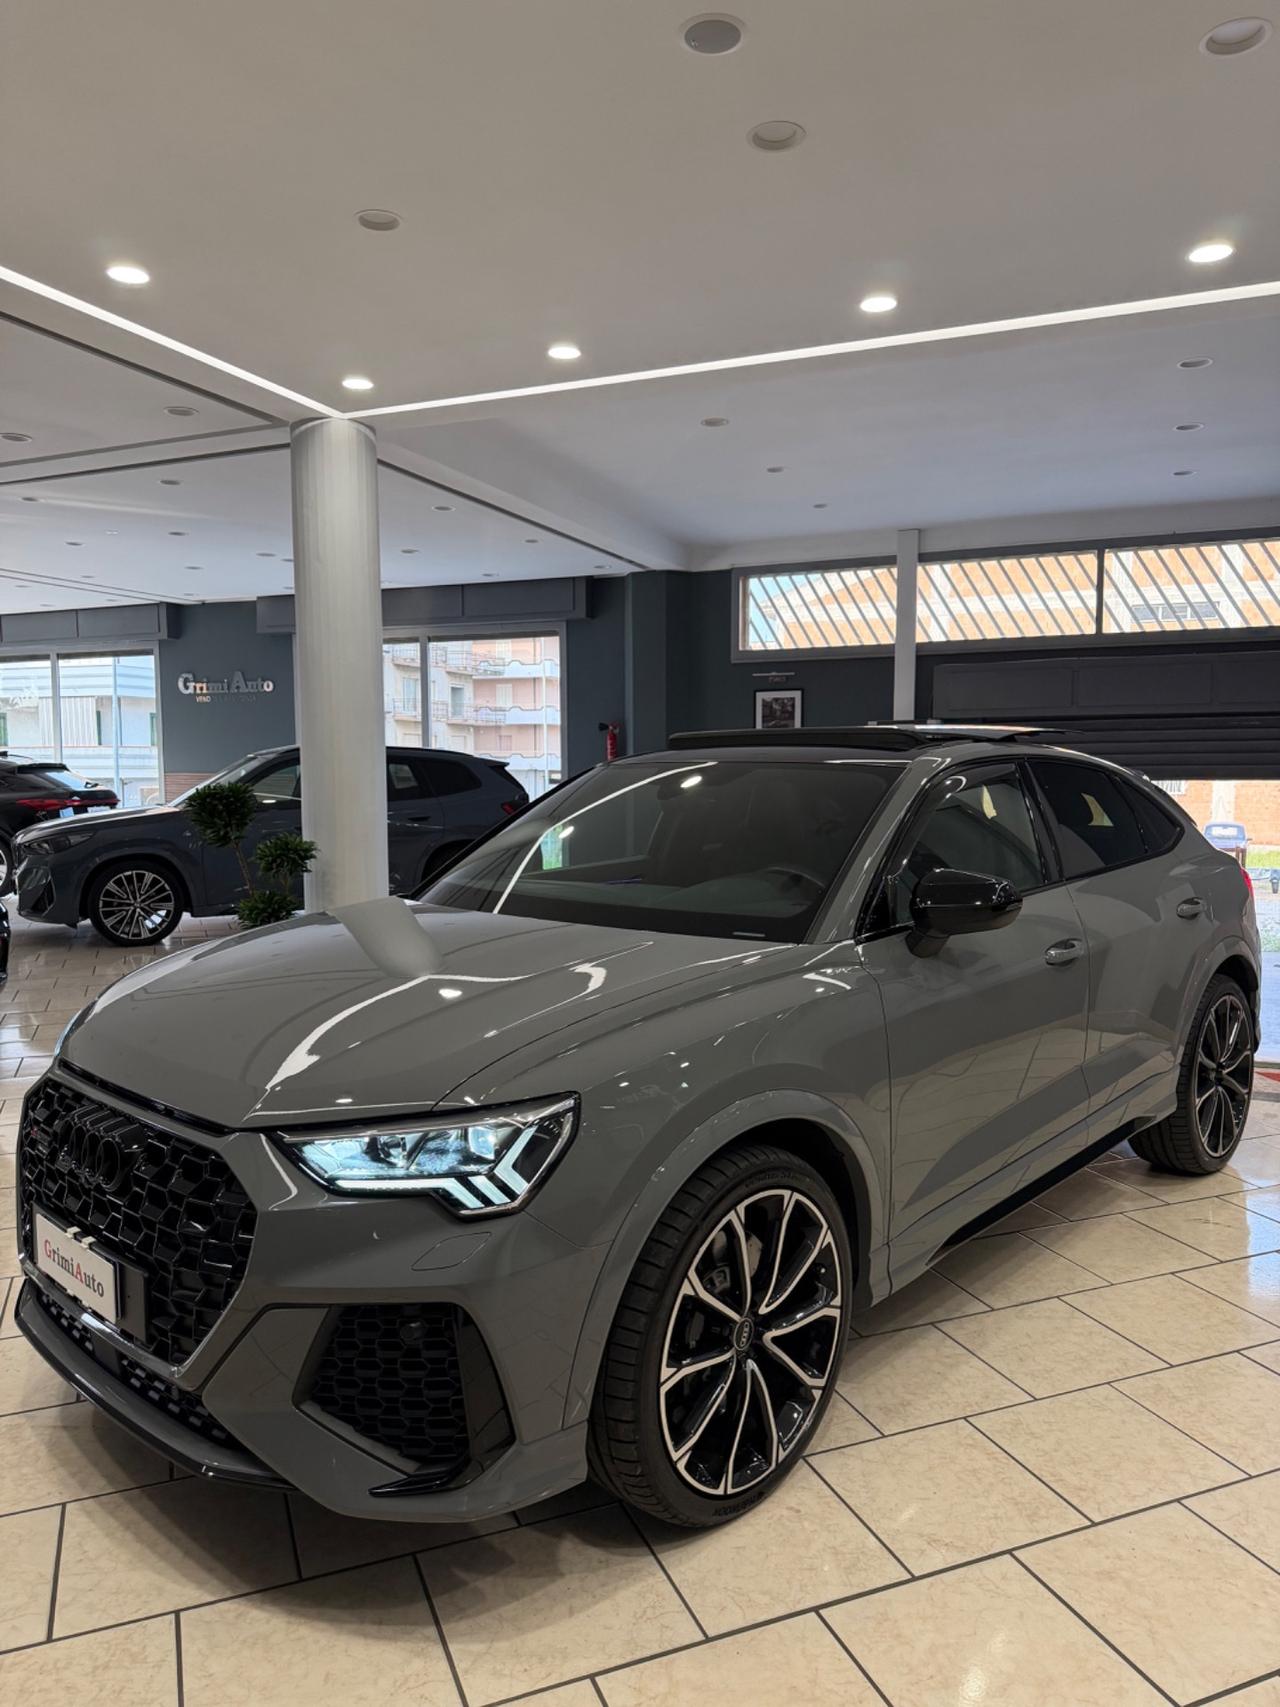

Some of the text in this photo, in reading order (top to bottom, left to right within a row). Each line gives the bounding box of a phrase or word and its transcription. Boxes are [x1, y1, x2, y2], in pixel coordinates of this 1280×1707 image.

[178, 670, 274, 694] Grimi Auto
[43, 1239, 105, 1297] GrimiAuto
